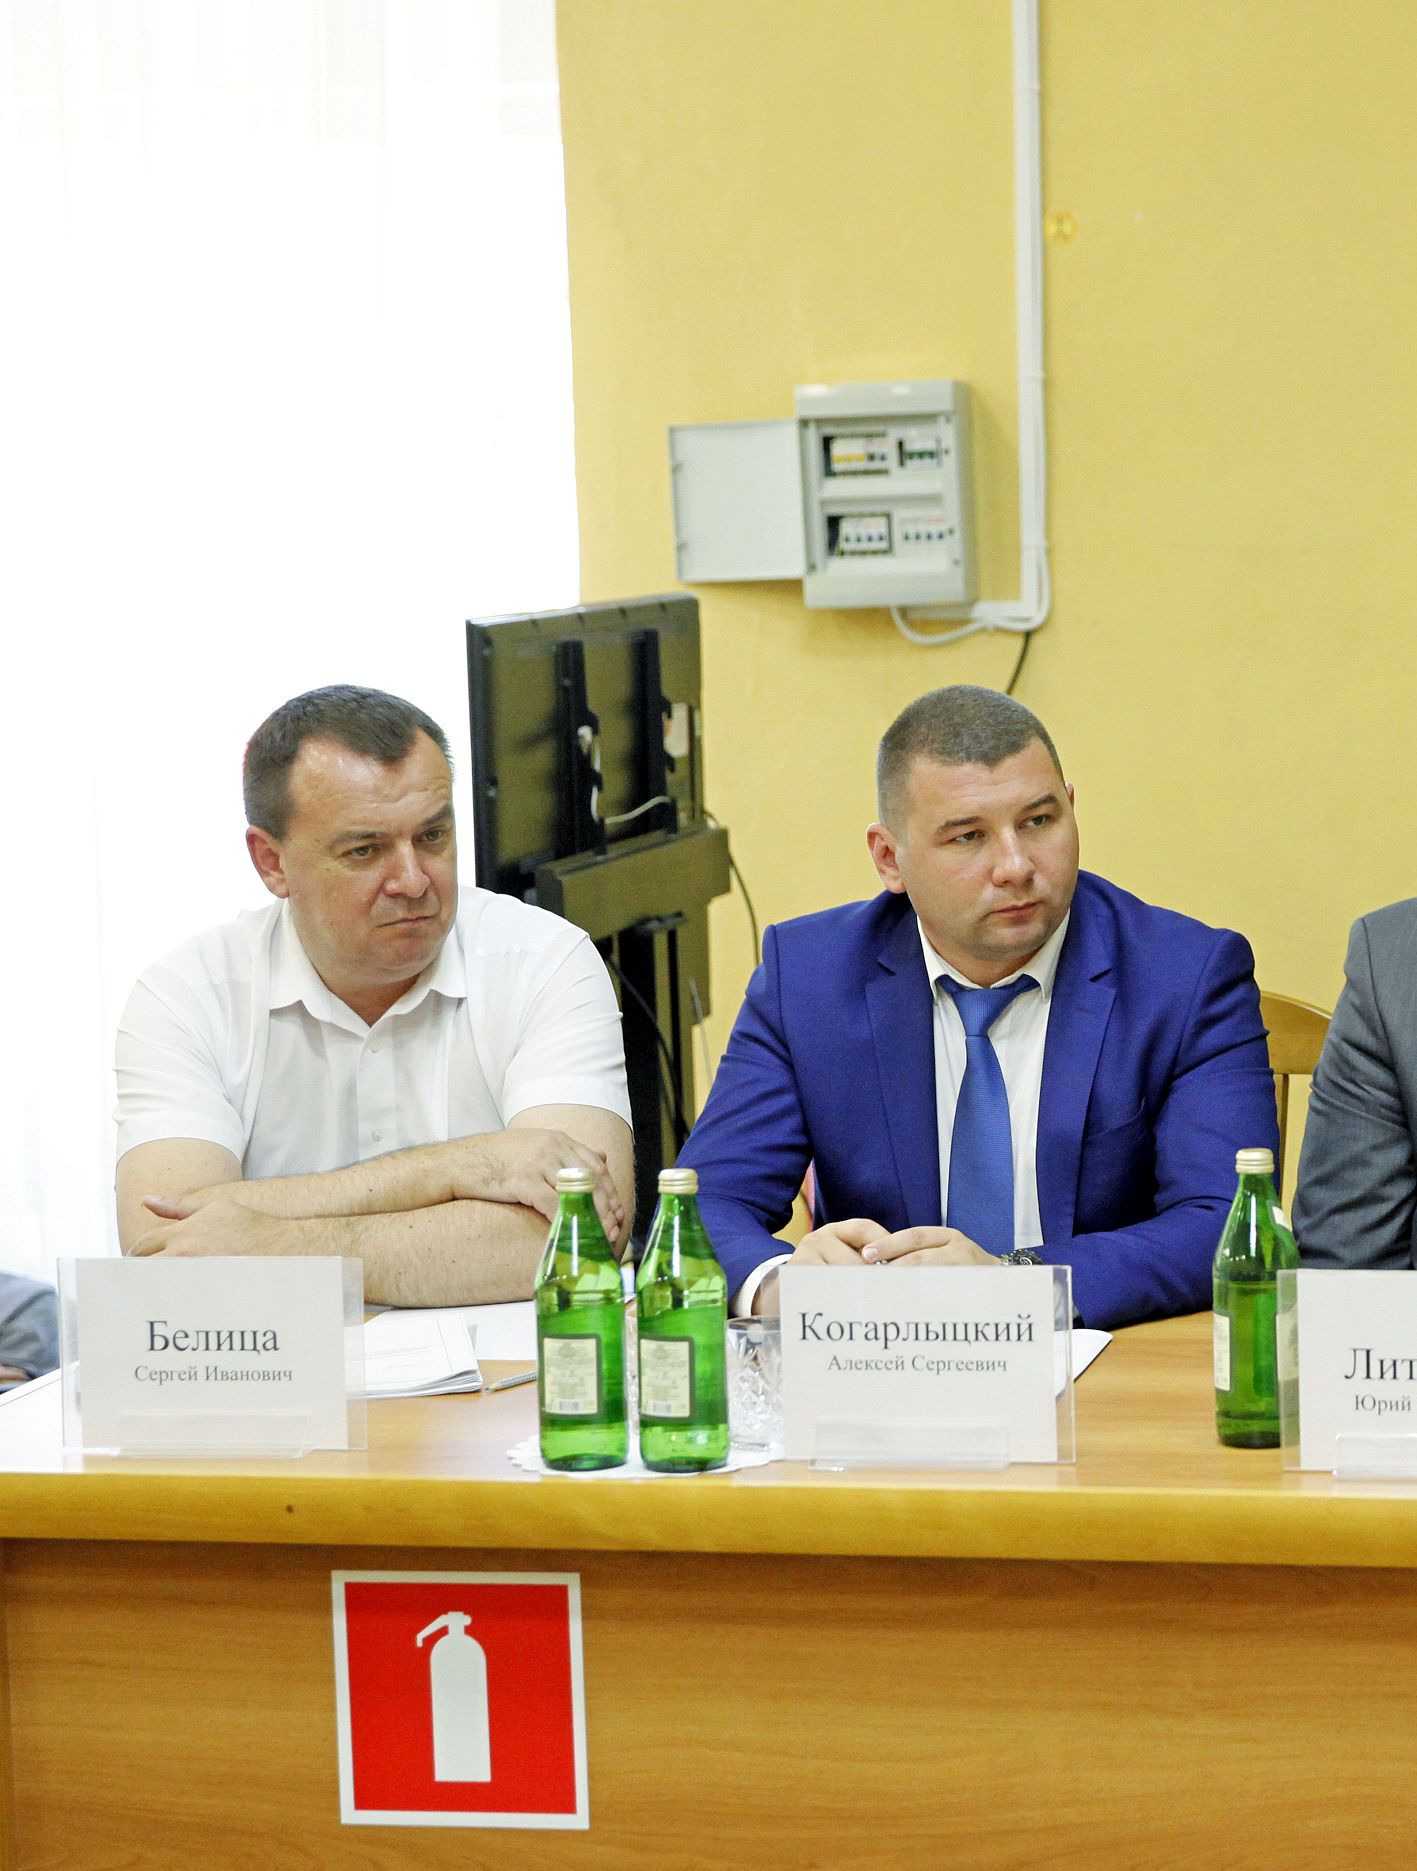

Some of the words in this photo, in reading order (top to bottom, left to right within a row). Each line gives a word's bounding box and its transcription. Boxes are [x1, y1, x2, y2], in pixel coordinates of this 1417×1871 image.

[147, 1320, 281, 1356] Белица
[799, 1311, 1035, 1349] Когарлыцкий
[133, 1364, 199, 1387] Сергей
[204, 1364, 293, 1383] Иванович
[827, 1354, 906, 1372] Алексей
[911, 1355, 1008, 1377] Сергеевич
[1354, 1394, 1412, 1417] Юрий
